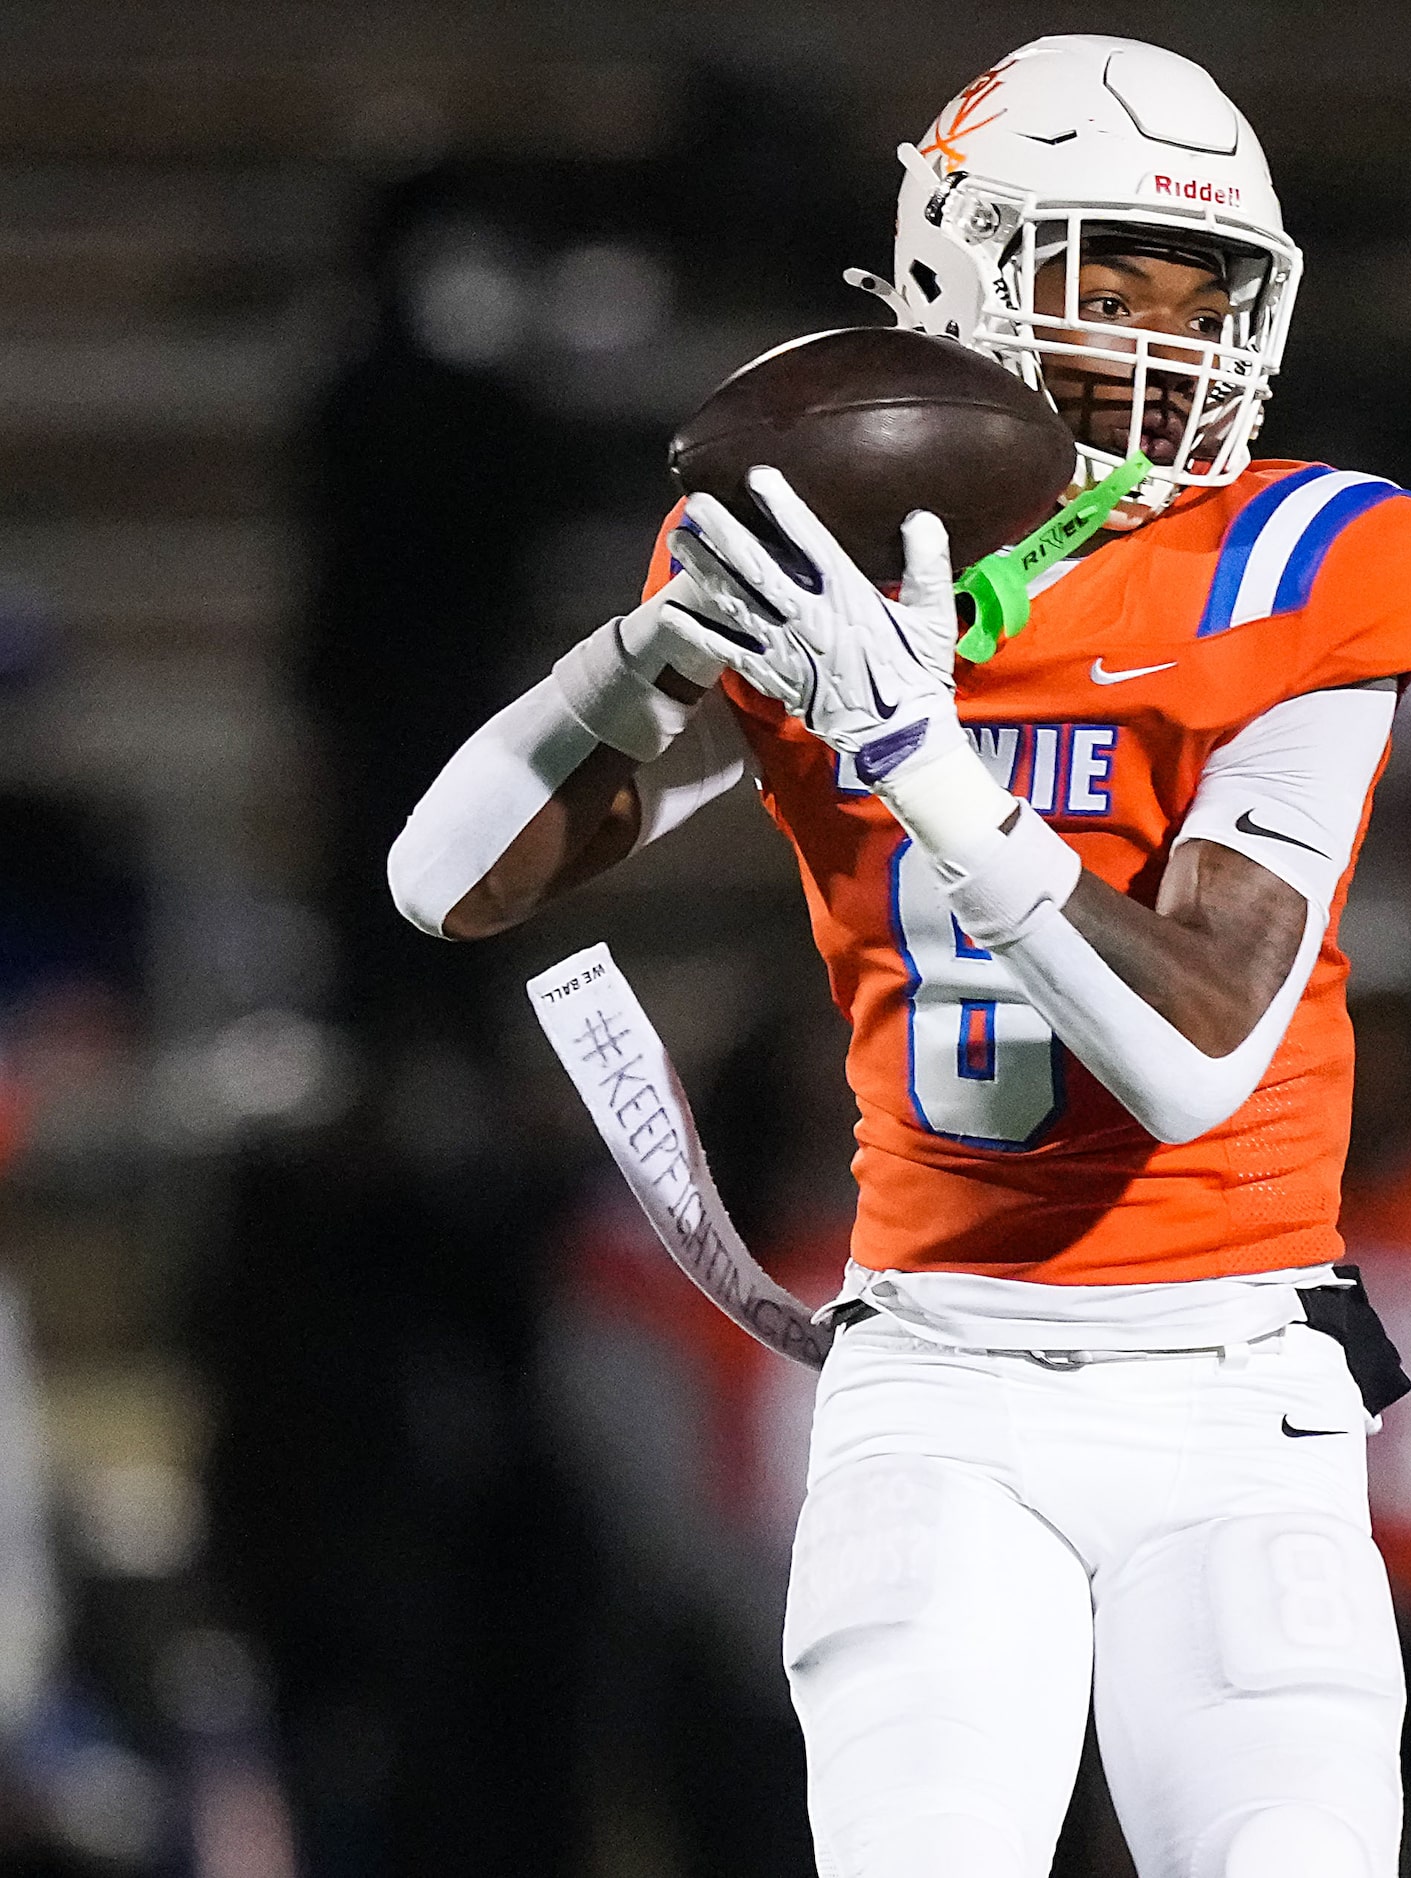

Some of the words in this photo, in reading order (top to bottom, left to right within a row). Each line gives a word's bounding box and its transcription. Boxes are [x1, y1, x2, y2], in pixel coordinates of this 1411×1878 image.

[1154, 174, 1241, 208] Riddell
[834, 723, 1121, 817] WIE
[581, 963, 606, 985] WE
[1268, 1530, 1357, 1647] 8
